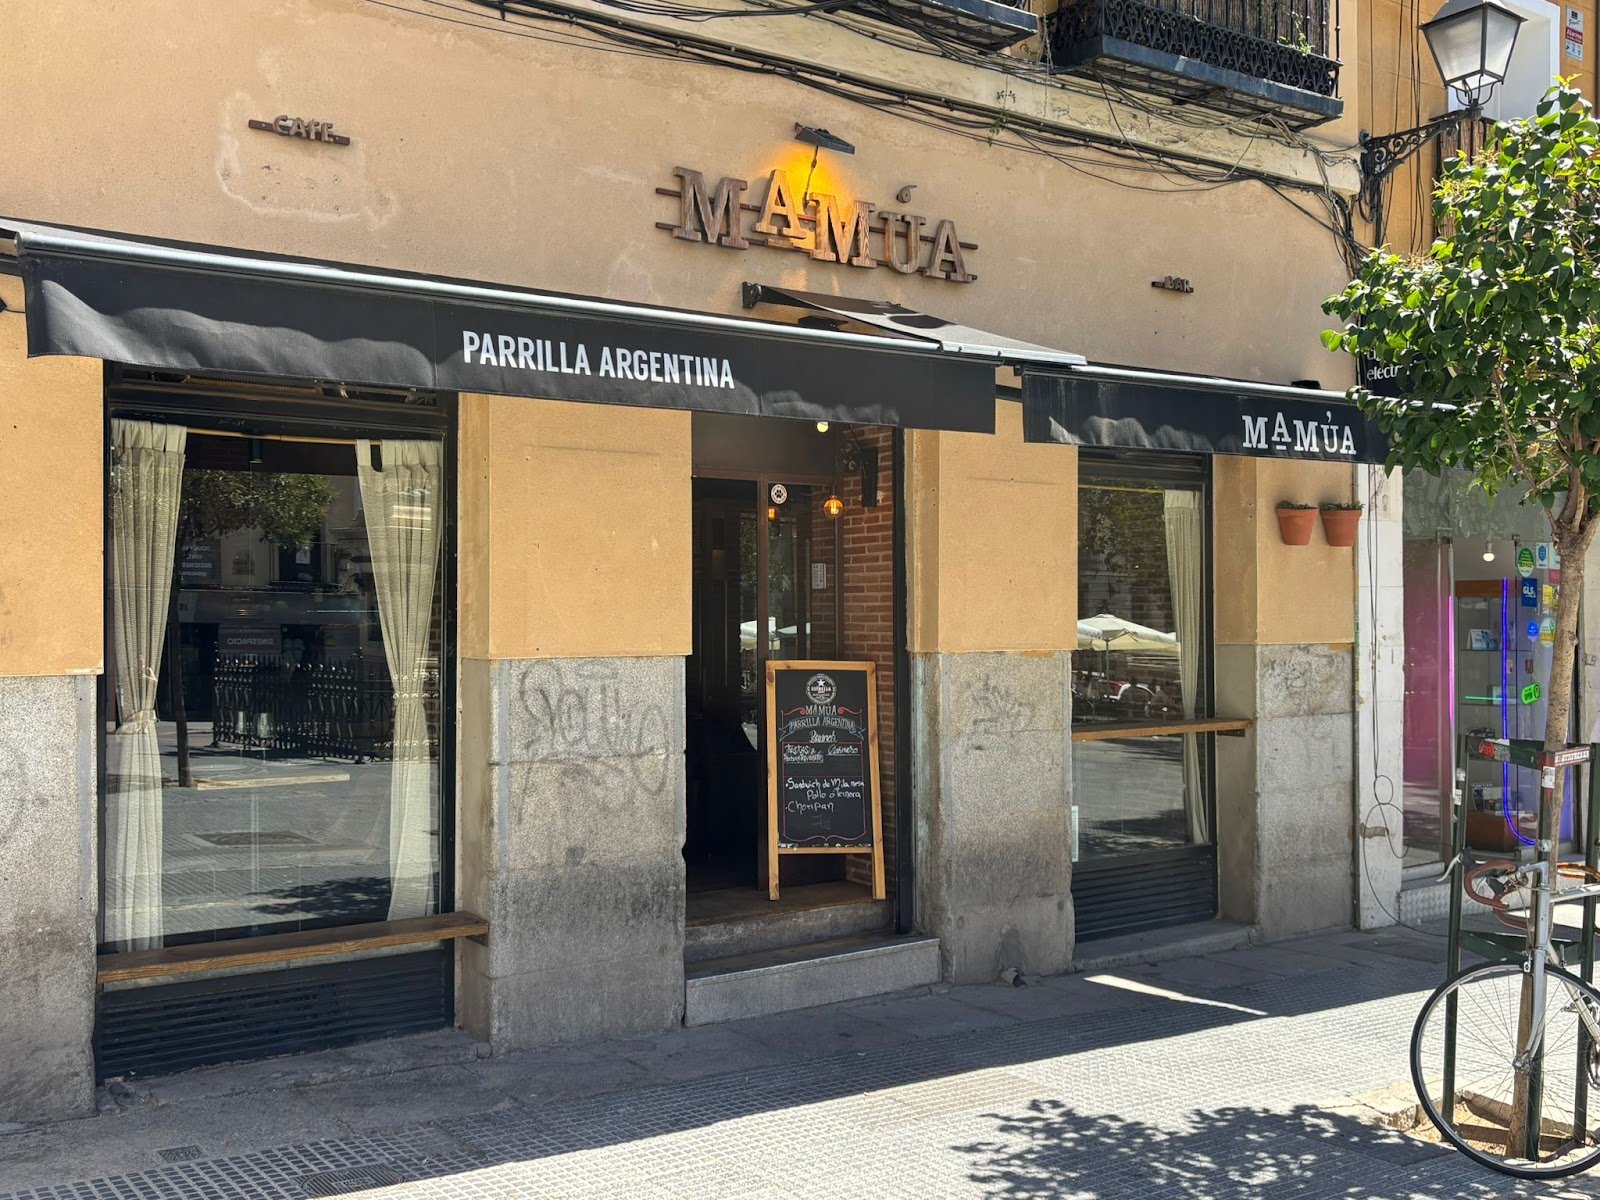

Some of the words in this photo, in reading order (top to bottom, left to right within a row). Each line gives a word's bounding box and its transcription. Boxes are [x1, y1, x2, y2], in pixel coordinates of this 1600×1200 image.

[672, 166, 976, 283] MAMÚA
[462, 330, 592, 376] PARRILLA
[599, 346, 735, 389] ARGENTINA
[1241, 410, 1357, 455] MAMÚA
[790, 716, 820, 730] PARRILLA
[822, 716, 855, 731] ARGENTINA
[805, 704, 837, 716] MAMÚA
[806, 789, 827, 801] Pollo
